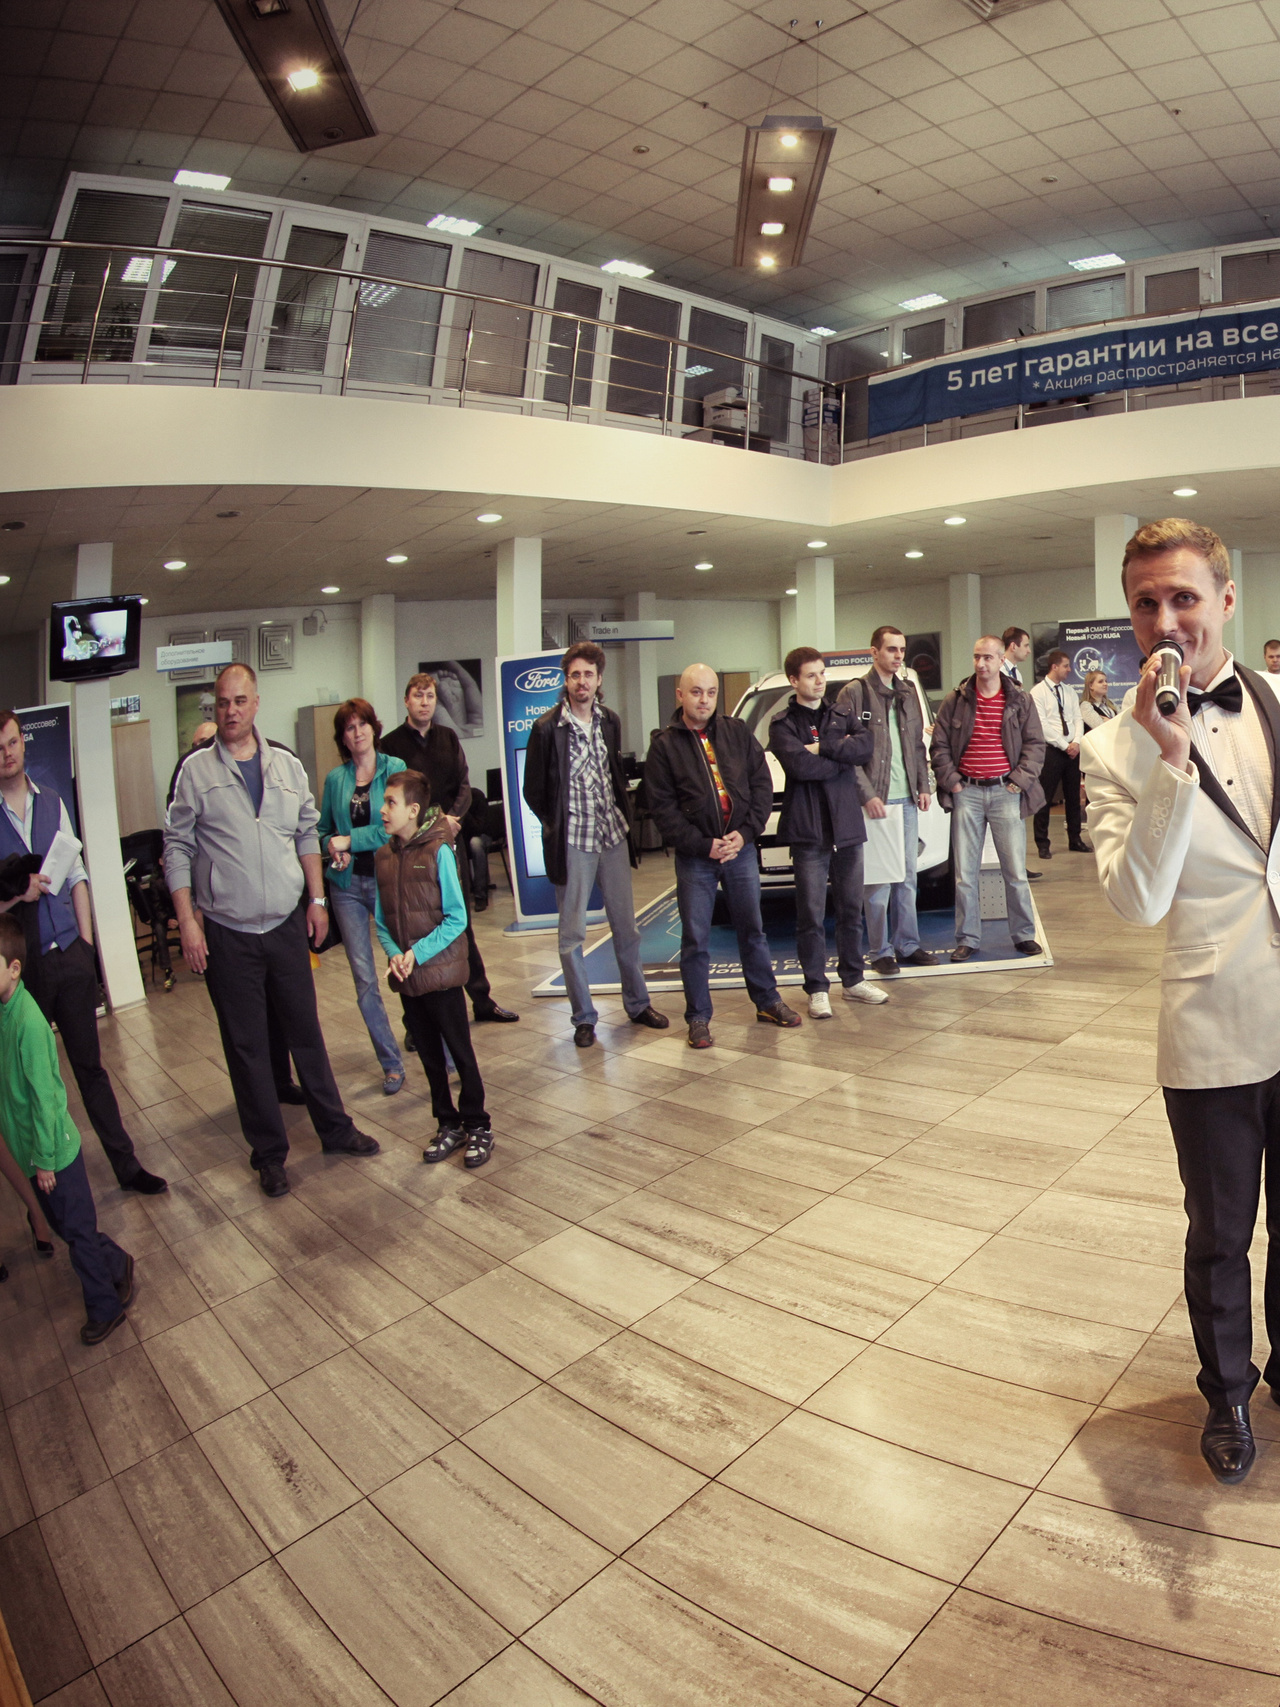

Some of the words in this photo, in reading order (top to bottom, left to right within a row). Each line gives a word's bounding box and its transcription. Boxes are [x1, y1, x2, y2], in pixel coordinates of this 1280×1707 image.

[947, 369, 963, 391] 5
[969, 362, 1018, 388] лет
[1025, 338, 1166, 377] гарантии
[1176, 330, 1214, 353] на
[1222, 322, 1279, 346] все
[1044, 373, 1093, 391] Акция
[1096, 349, 1257, 385] распространяется
[592, 626, 611, 635] Trade
[1090, 625, 1134, 633] СМАРТ-кроссов
[850, 656, 874, 664] FOCUS
[524, 670, 561, 690] Ford
[508, 718, 537, 733] FOR
